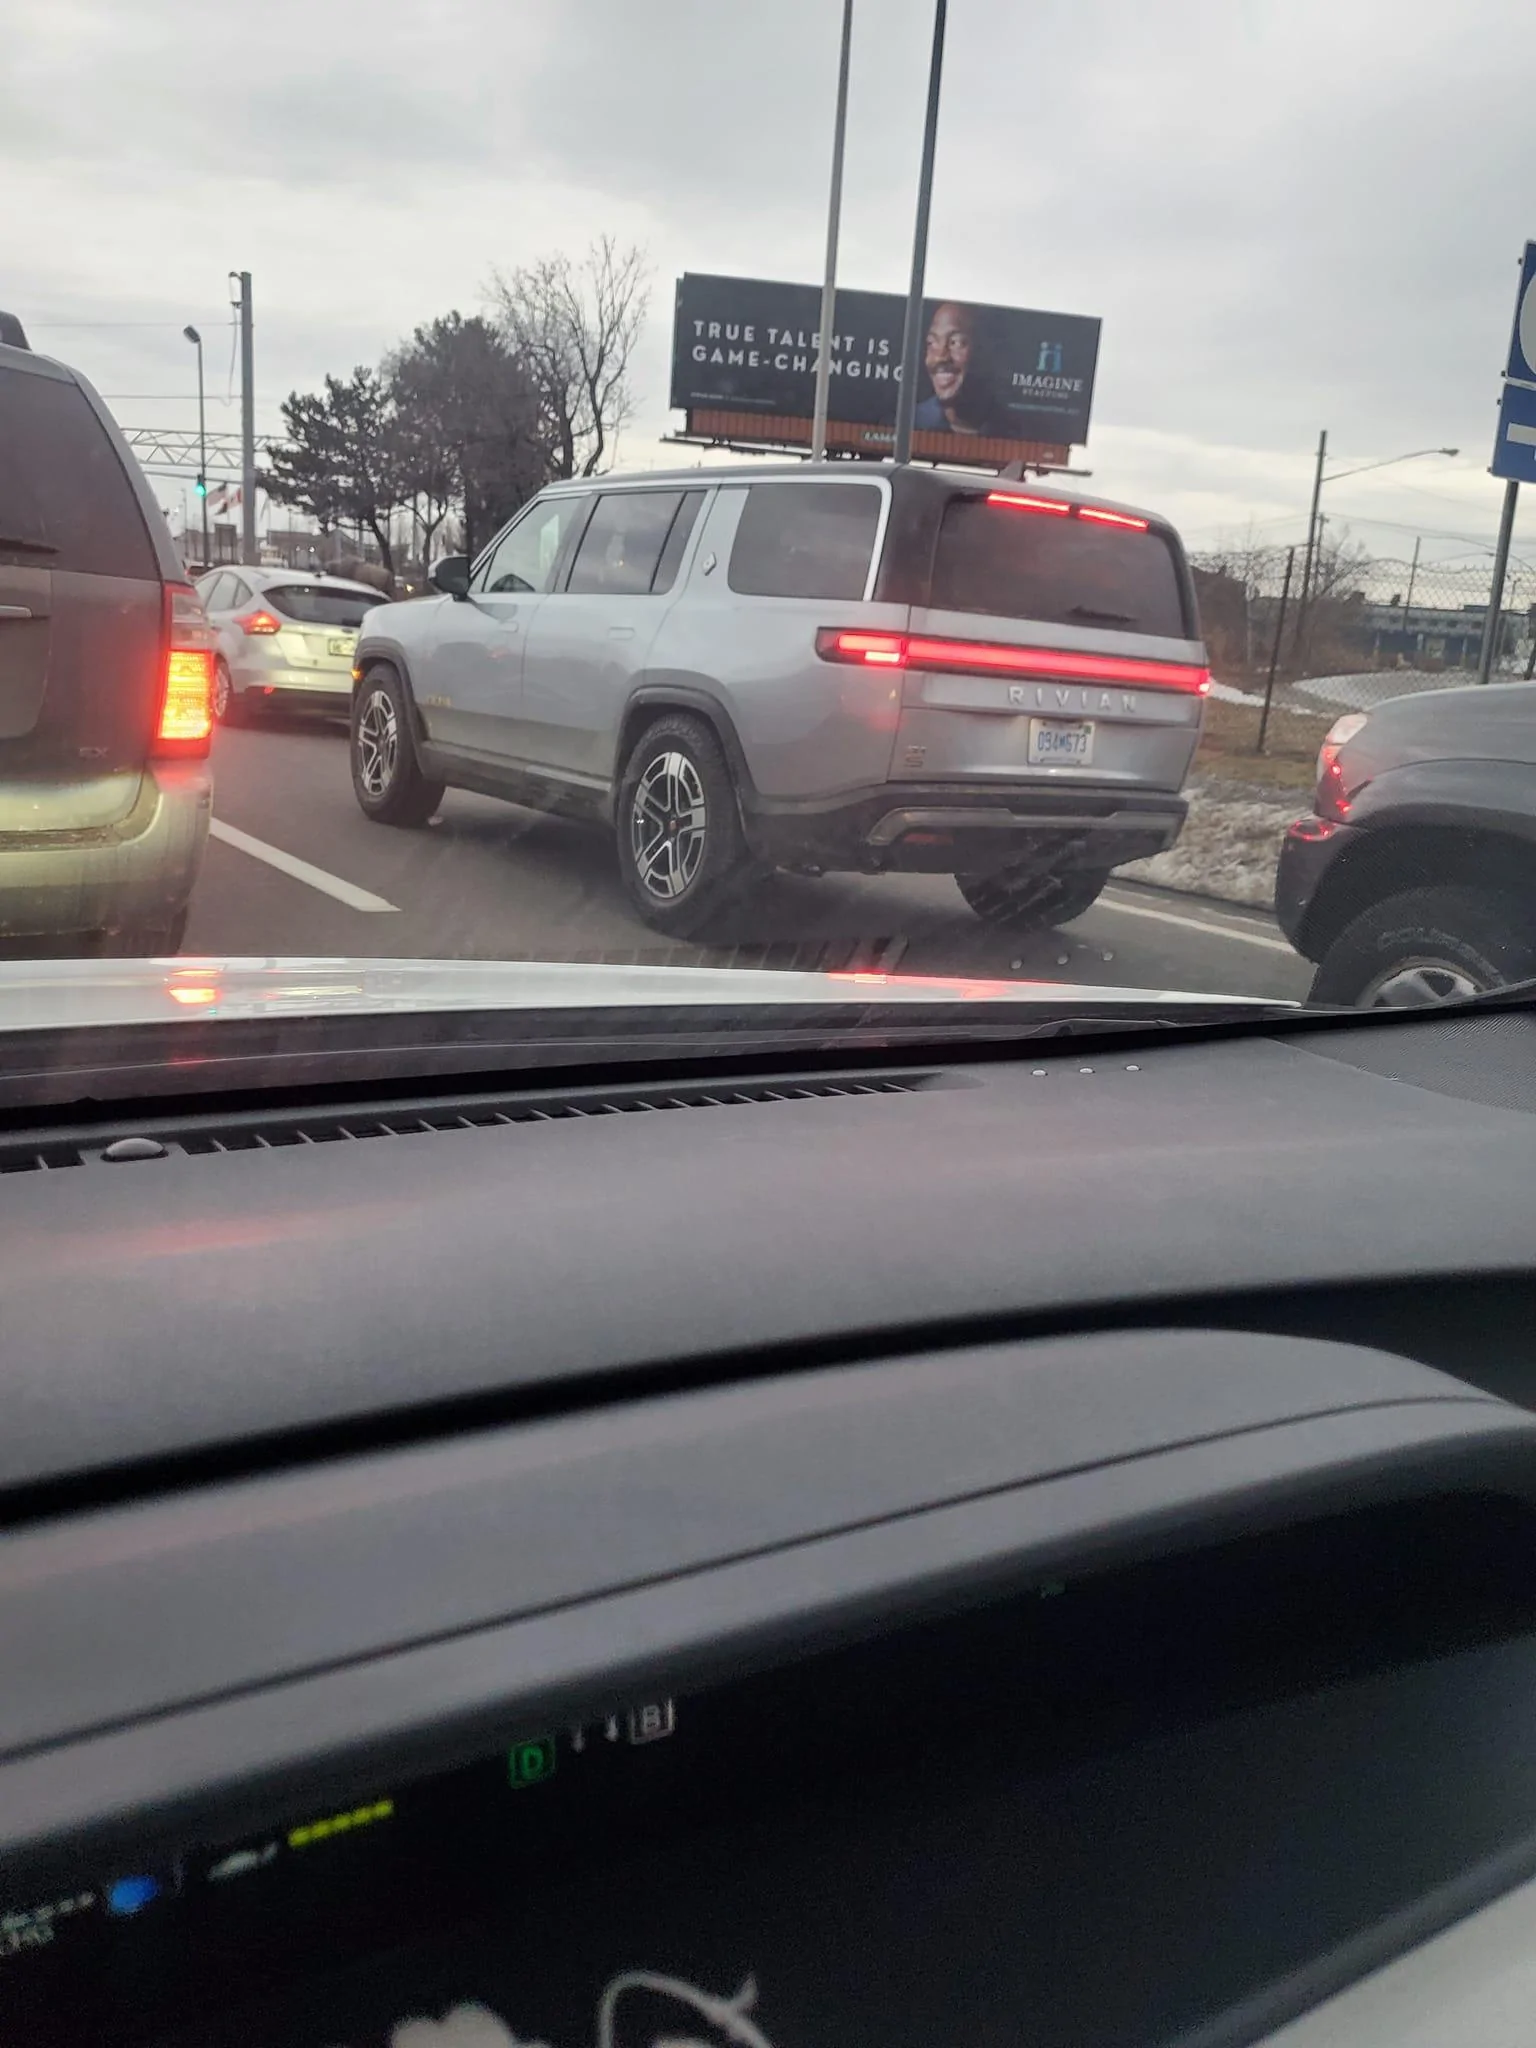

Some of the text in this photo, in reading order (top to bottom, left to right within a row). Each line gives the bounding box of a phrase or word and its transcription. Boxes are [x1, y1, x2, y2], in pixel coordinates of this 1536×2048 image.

[693, 320, 889, 356] TRUE TALENT IS
[1012, 372, 1083, 393] IMAGINE
[1007, 686, 1137, 713] RIVIAN
